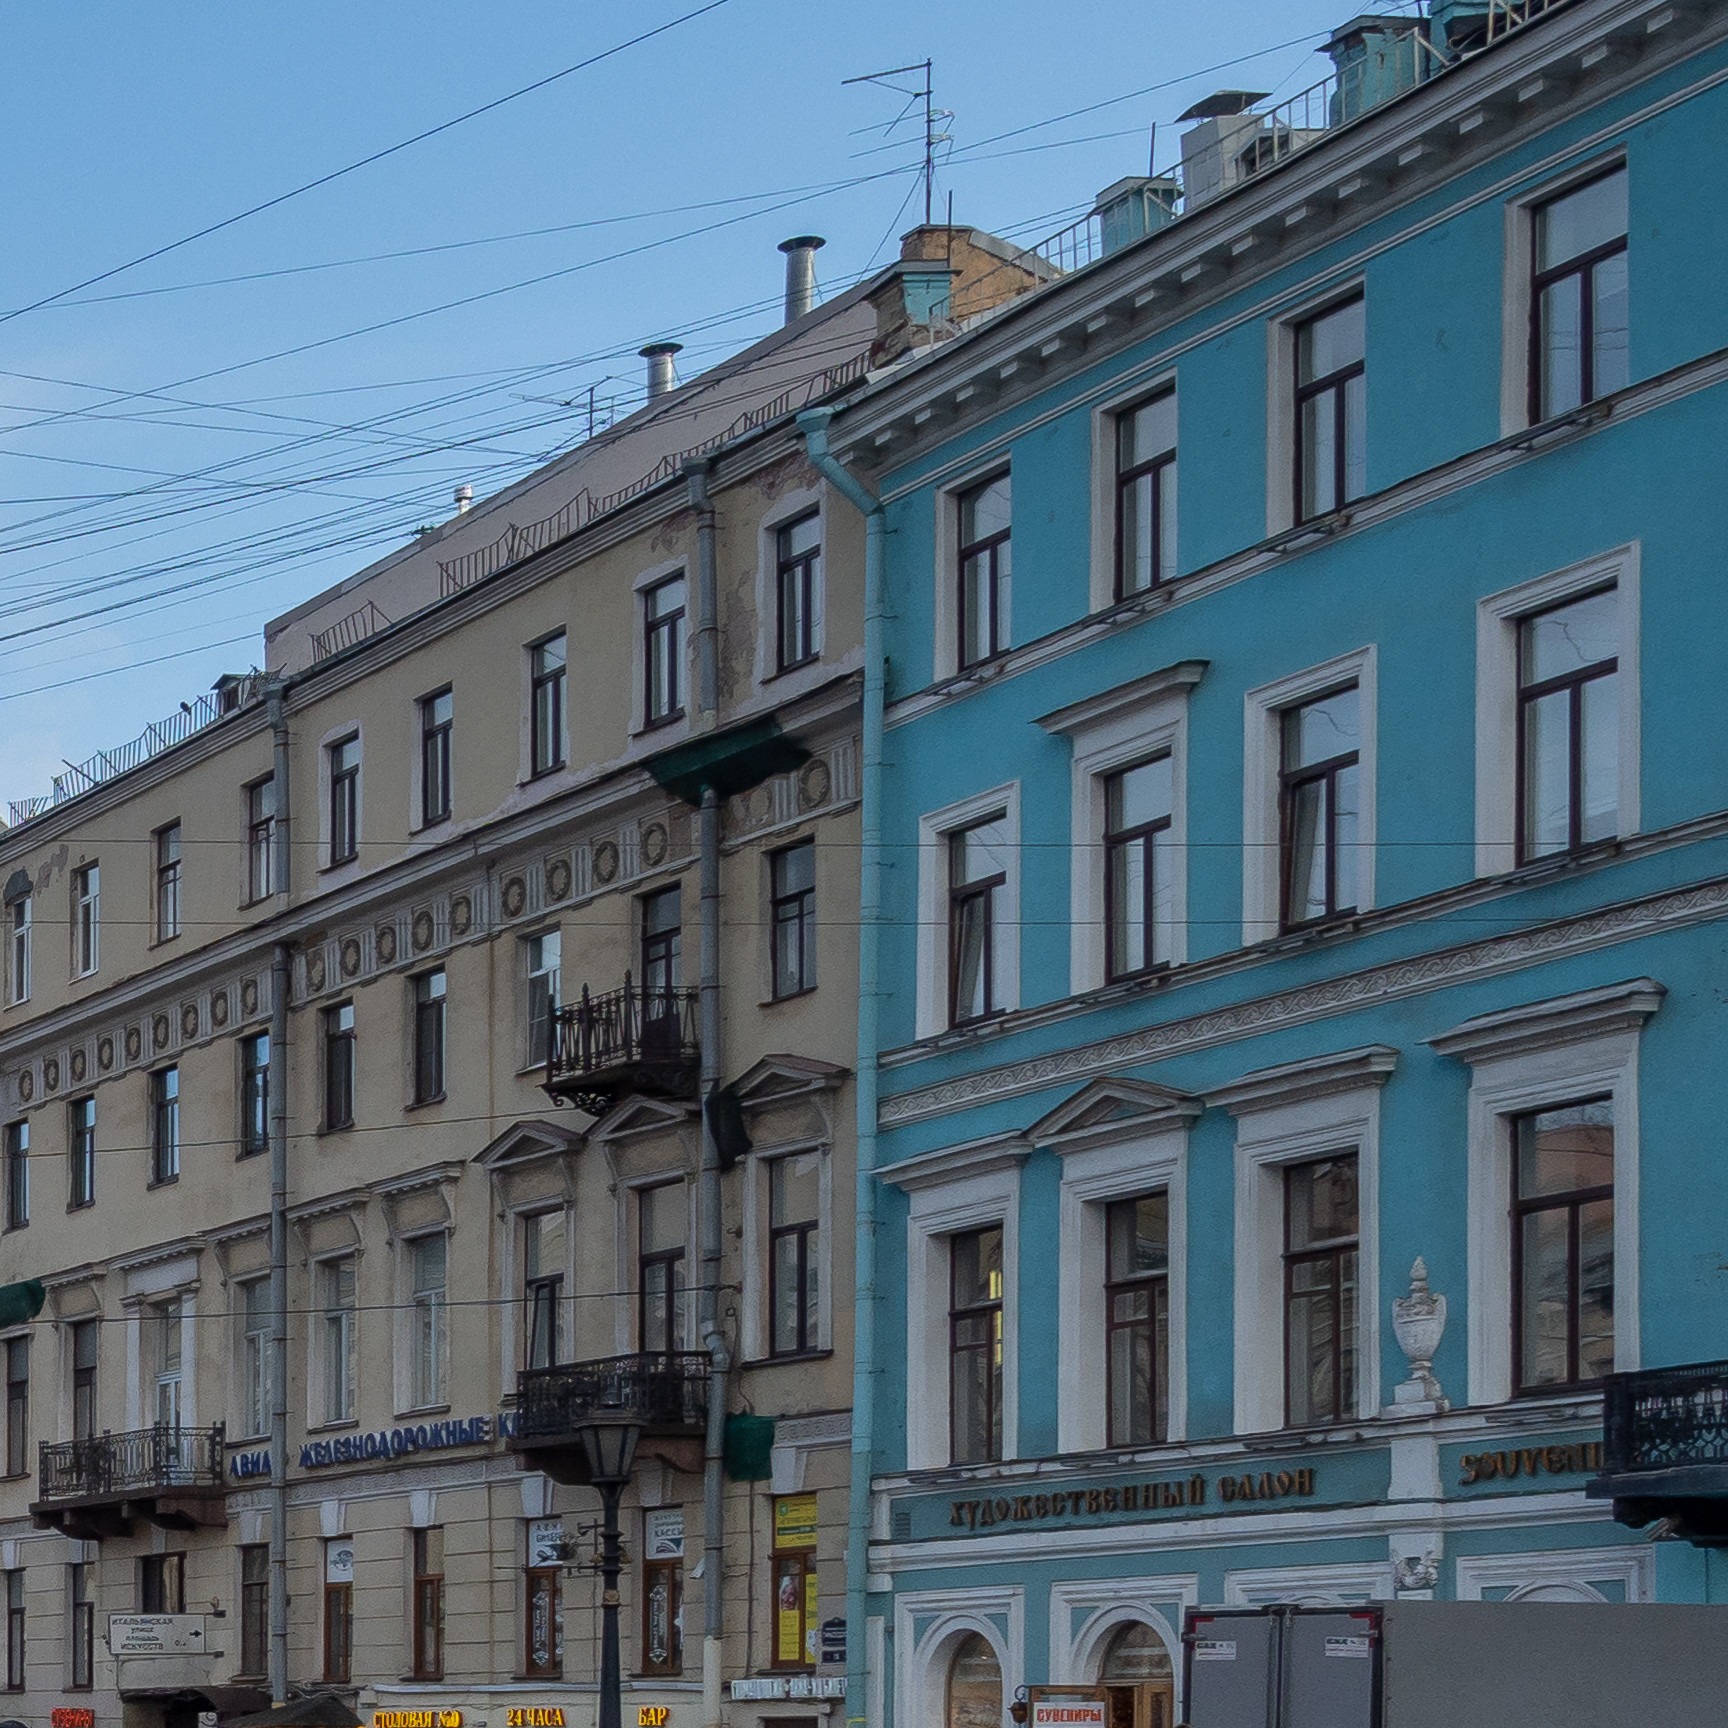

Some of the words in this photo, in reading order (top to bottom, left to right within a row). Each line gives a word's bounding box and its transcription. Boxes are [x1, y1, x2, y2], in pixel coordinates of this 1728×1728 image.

[230, 1450, 271, 1479] АВИА
[299, 1416, 487, 1468] ЖЕЛЕЗНОДОРОЖНЫЕ
[949, 1474, 1205, 1530] ХУДОЖЕСТВЕННЫЙ
[1218, 1467, 1314, 1502] САЛОН
[374, 1711, 432, 1728] СТОЛОВАЯ
[507, 1708, 523, 1727] 24
[526, 1707, 565, 1727] ЧАСА
[638, 1706, 668, 1727] БАР
[1037, 1708, 1102, 1722] СУВЕНИРЫ
